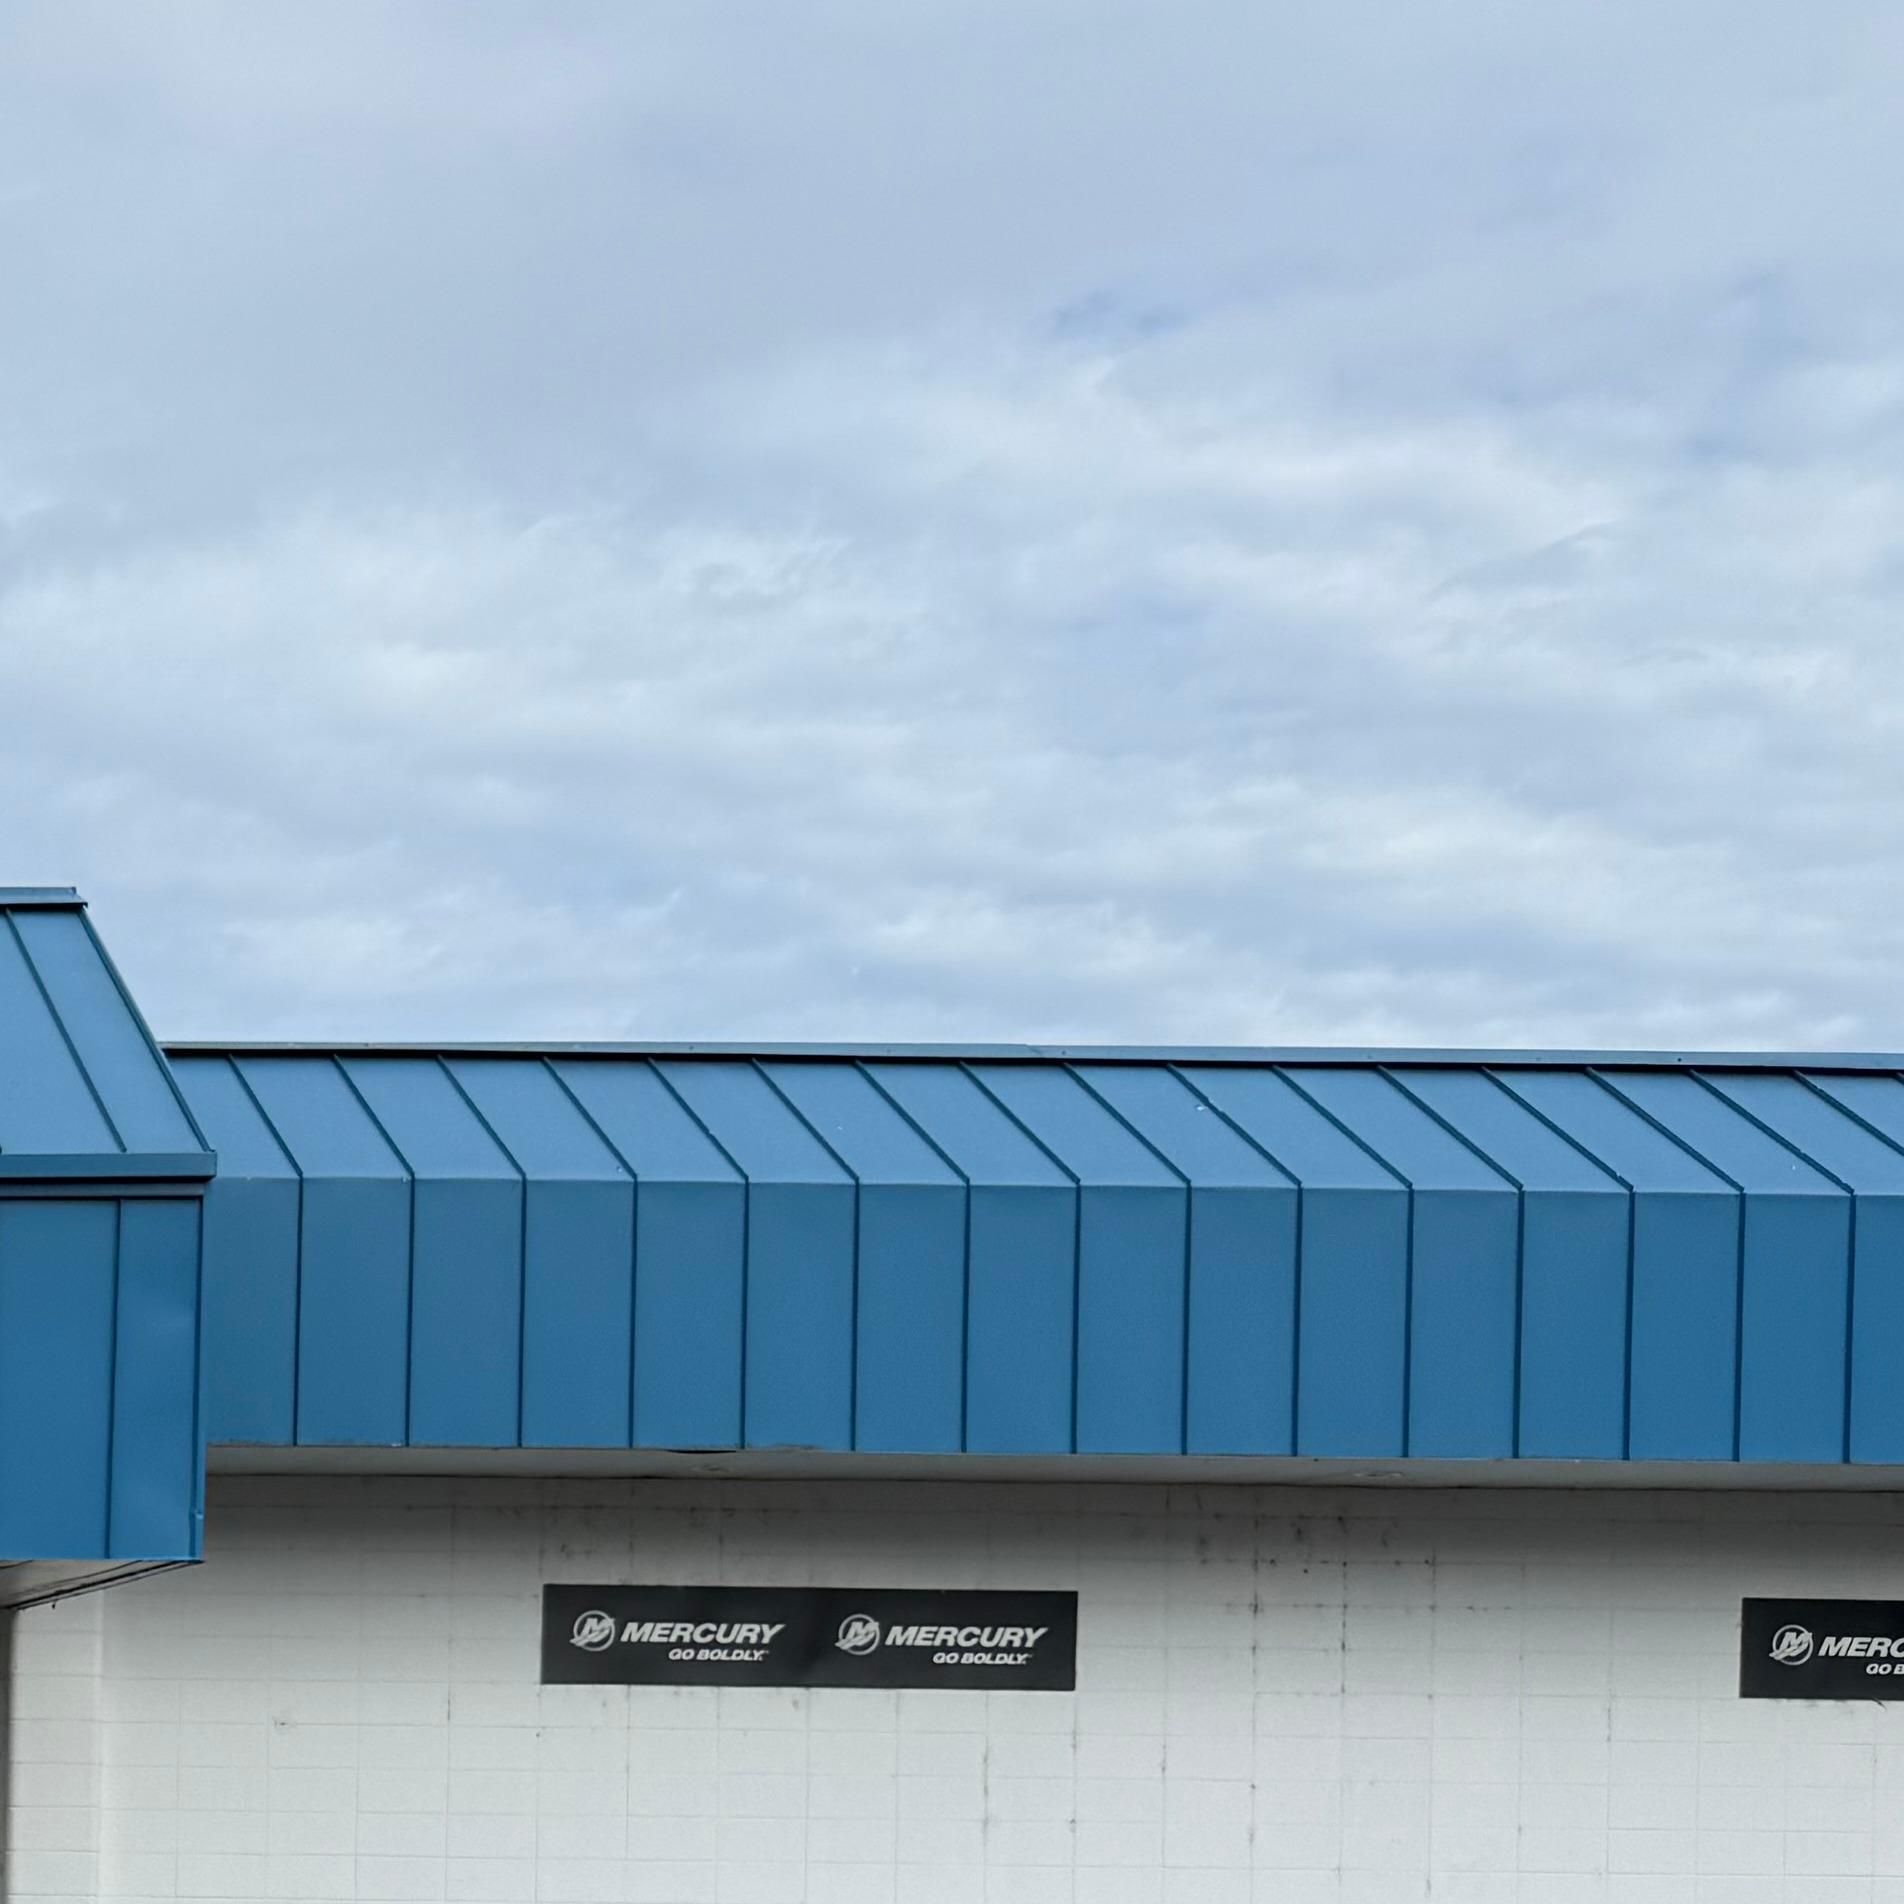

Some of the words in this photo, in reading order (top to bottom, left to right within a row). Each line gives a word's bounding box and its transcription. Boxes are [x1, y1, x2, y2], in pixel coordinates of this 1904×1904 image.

[620, 1621, 785, 1645] MERCURY
[885, 1626, 1049, 1648] MERCURY
[668, 1648, 694, 1661] GO
[932, 1652, 958, 1665] GO
[1865, 1663, 1892, 1675] GO
